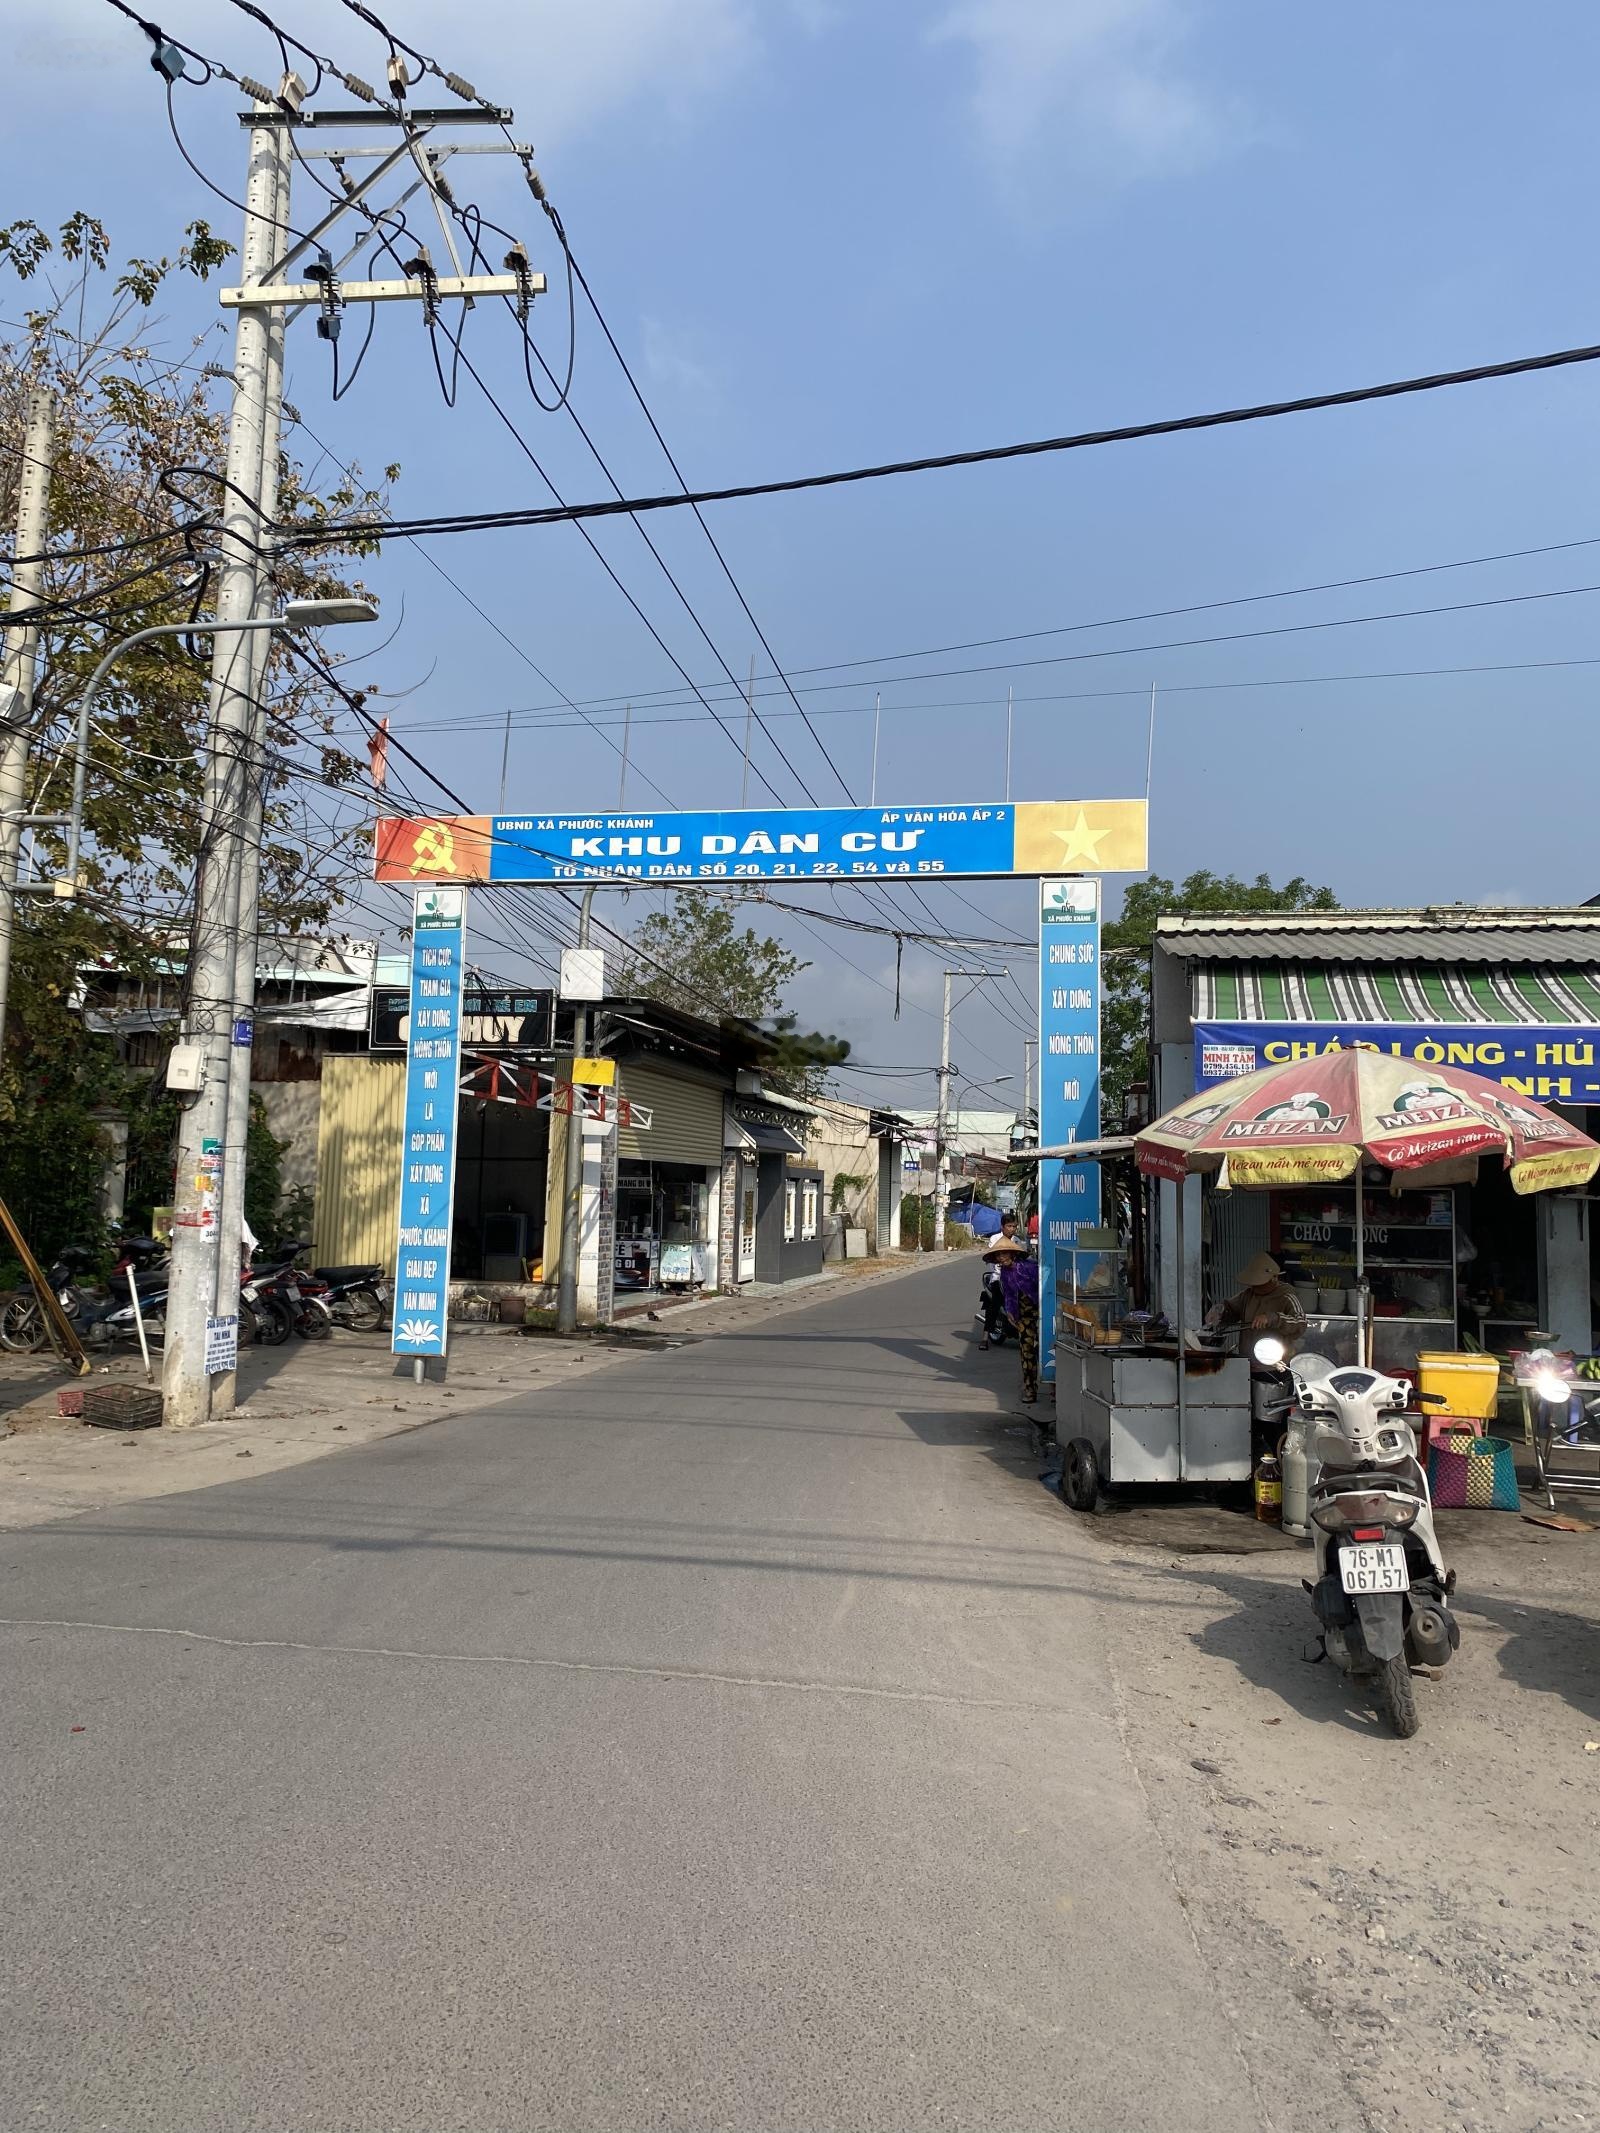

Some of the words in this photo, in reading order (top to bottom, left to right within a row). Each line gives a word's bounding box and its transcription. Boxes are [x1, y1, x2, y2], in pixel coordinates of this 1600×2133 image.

[497, 821, 533, 830] UBND
[537, 820, 555, 830] XÃ
[559, 818, 603, 830] PHƯỚC
[607, 817, 653, 829] KHÁNH
[905, 811, 934, 822] VĂN
[938, 810, 967, 821] HÓA
[996, 811, 1005, 820] 2
[571, 836, 680, 857] KHU
[701, 830, 819, 855] DÂN
[841, 829, 925, 852] CƯ
[584, 863, 641, 876] NHÂN
[649, 863, 691, 876] DÂN
[699, 860, 727, 875] SỐ
[734, 864, 766, 876] 20,
[773, 863, 804, 876] 21,
[812, 862, 844, 875] 22,
[852, 862, 878, 873] 54
[885, 861, 910, 873] và
[918, 860, 945, 872] 55
[1049, 944, 1075, 964] CHUNG
[1078, 940, 1094, 964] SỨC
[420, 979, 438, 997] THAM
[440, 979, 451, 997] GIA
[1052, 986, 1067, 1009] XÂY
[1069, 989, 1092, 1013] DỰNG
[417, 1006, 430, 1028] XÂY
[431, 1008, 451, 1032] DỰNG
[414, 1037, 432, 1058] NÔNG
[434, 1037, 452, 1058] THÔN
[1049, 1032, 1071, 1054] NÔNG
[1073, 1032, 1094, 1054] THÔN
[1536, 1038, 1593, 1065] HỦ
[1204, 1054, 1230, 1062] MINH
[1233, 1052, 1255, 1063] TÂM
[1064, 1077, 1080, 1101] MỚI
[1227, 1119, 1345, 1136] MEIZAN
[411, 1130, 424, 1152] GÓP
[1407, 1138, 1454, 1158] Meizan
[410, 1161, 423, 1183] XÂY
[424, 1164, 444, 1187] DỰNG
[1266, 1156, 1289, 1169] nấu
[1312, 1159, 1345, 1172] ngay
[1074, 1174, 1085, 1193] NO
[400, 1225, 422, 1247] PHƯỚC
[424, 1225, 447, 1247] KHÁNH
[1049, 1220, 1071, 1245] HẠNH
[404, 1289, 417, 1311] VĂN
[418, 1292, 437, 1311] MINH
[1346, 1569, 1402, 1590] 067.57
